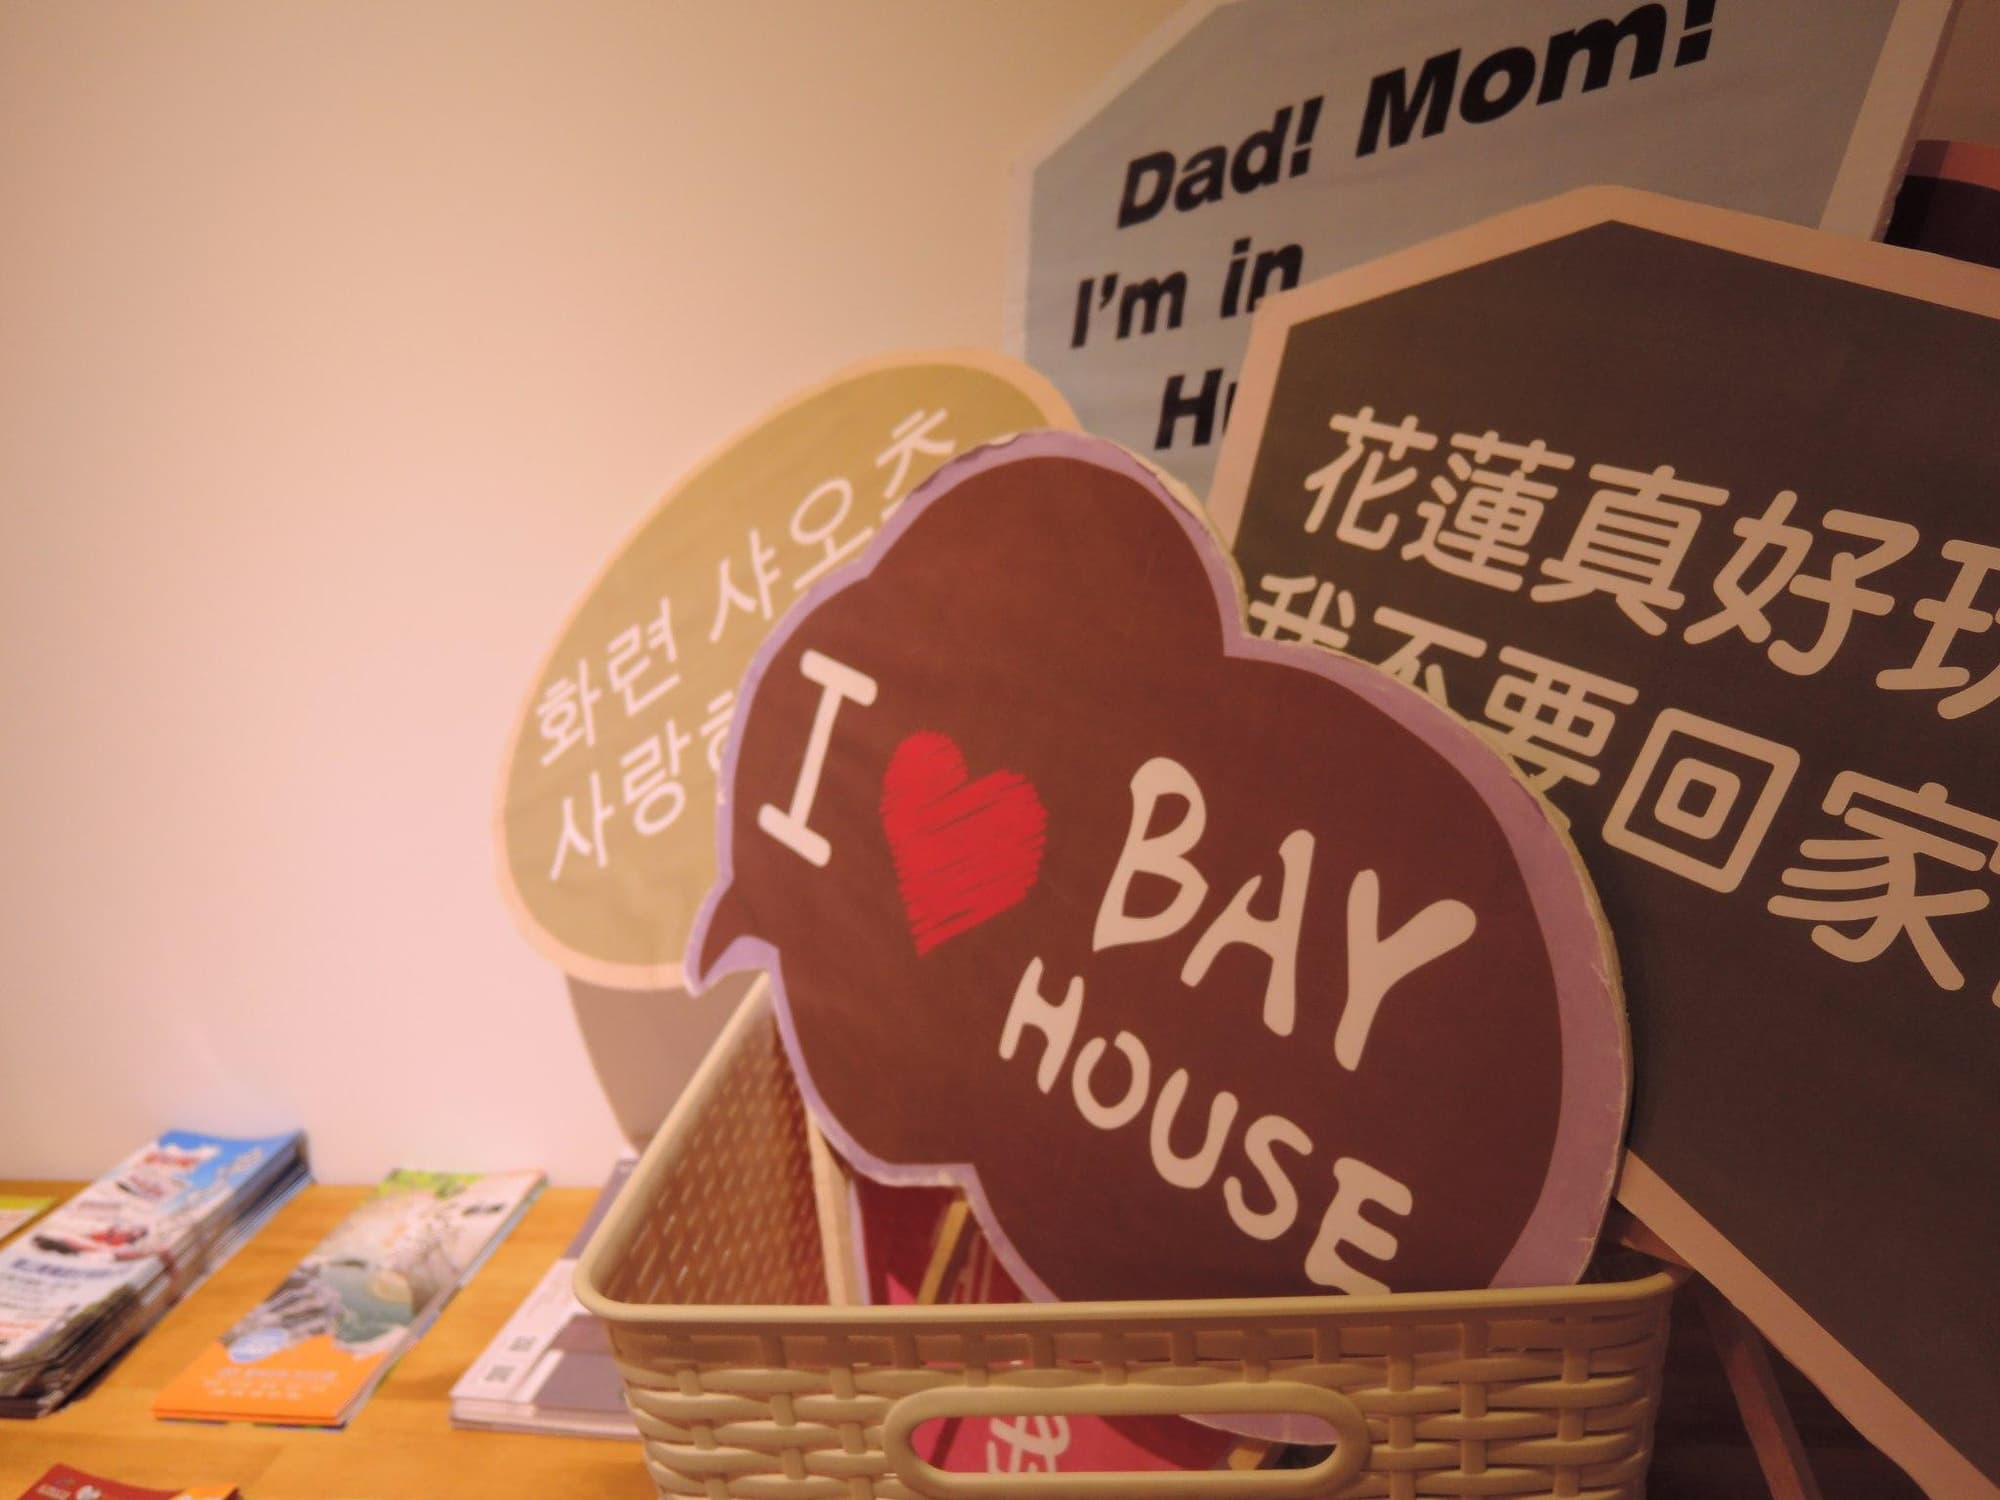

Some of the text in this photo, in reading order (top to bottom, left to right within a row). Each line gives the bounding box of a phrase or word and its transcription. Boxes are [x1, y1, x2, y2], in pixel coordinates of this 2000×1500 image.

[1117, 0, 1715, 229] Dad! Mom!
[1220, 237, 1303, 319] in
[535, 594, 681, 767] 화련
[757, 648, 1477, 1072] I BAY
[998, 955, 1413, 1296] HOUSE
